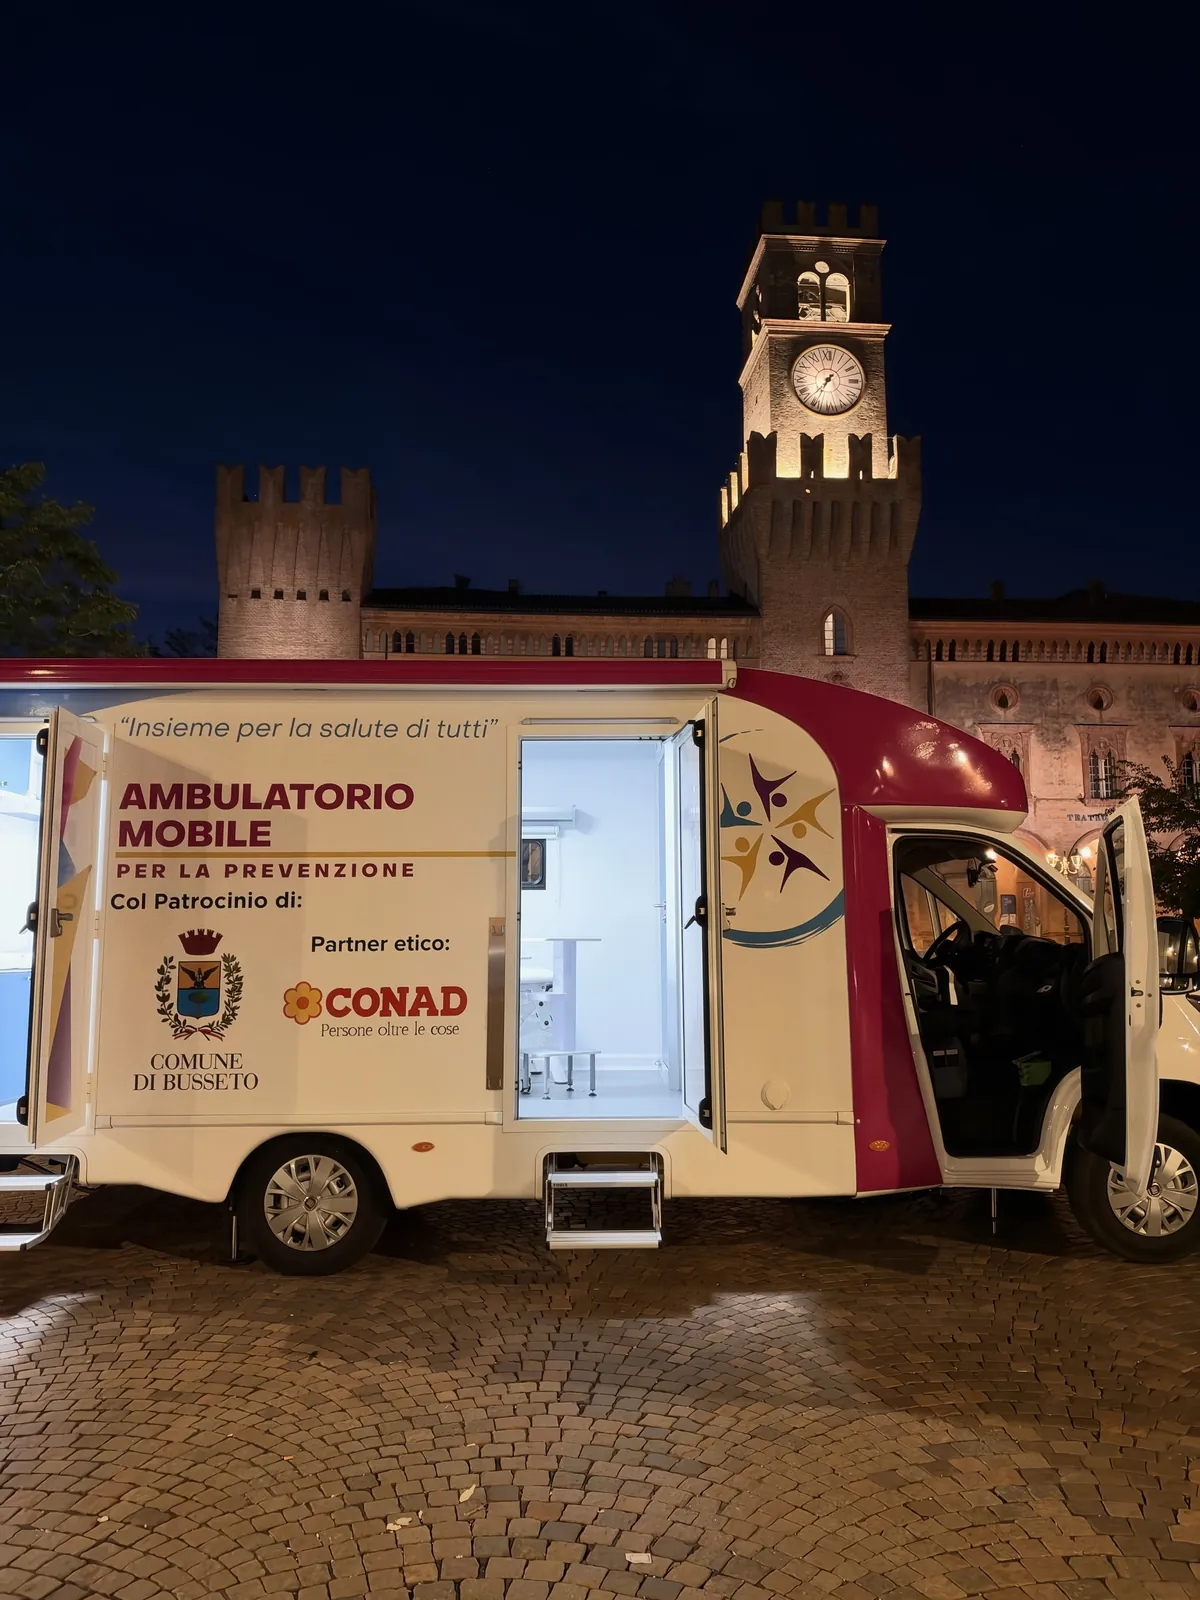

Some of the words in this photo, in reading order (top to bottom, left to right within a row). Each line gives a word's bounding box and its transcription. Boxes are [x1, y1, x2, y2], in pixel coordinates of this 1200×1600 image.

[236, 722, 283, 743] per
[288, 717, 313, 738] la
[319, 717, 399, 738] salute
[406, 718, 430, 738] di
[118, 782, 415, 811] AMBULATORIO
[118, 819, 272, 848] MOBILE
[116, 863, 166, 879] PER
[179, 863, 210, 879] LA
[224, 862, 414, 879] PREVENZIONE
[110, 892, 147, 910] Col
[154, 891, 268, 910] Patrocinio
[275, 890, 303, 909] di:
[311, 935, 389, 953] Partner
[394, 933, 450, 952] etico:
[325, 985, 468, 1018] CONAD
[321, 1023, 373, 1037] Persone
[377, 1021, 409, 1036] oltre
[414, 1021, 426, 1036] le
[430, 1025, 460, 1036] cose
[150, 1053, 243, 1071] COMUNE
[133, 1073, 157, 1091] DI
[162, 1072, 259, 1091] BUSSETO
